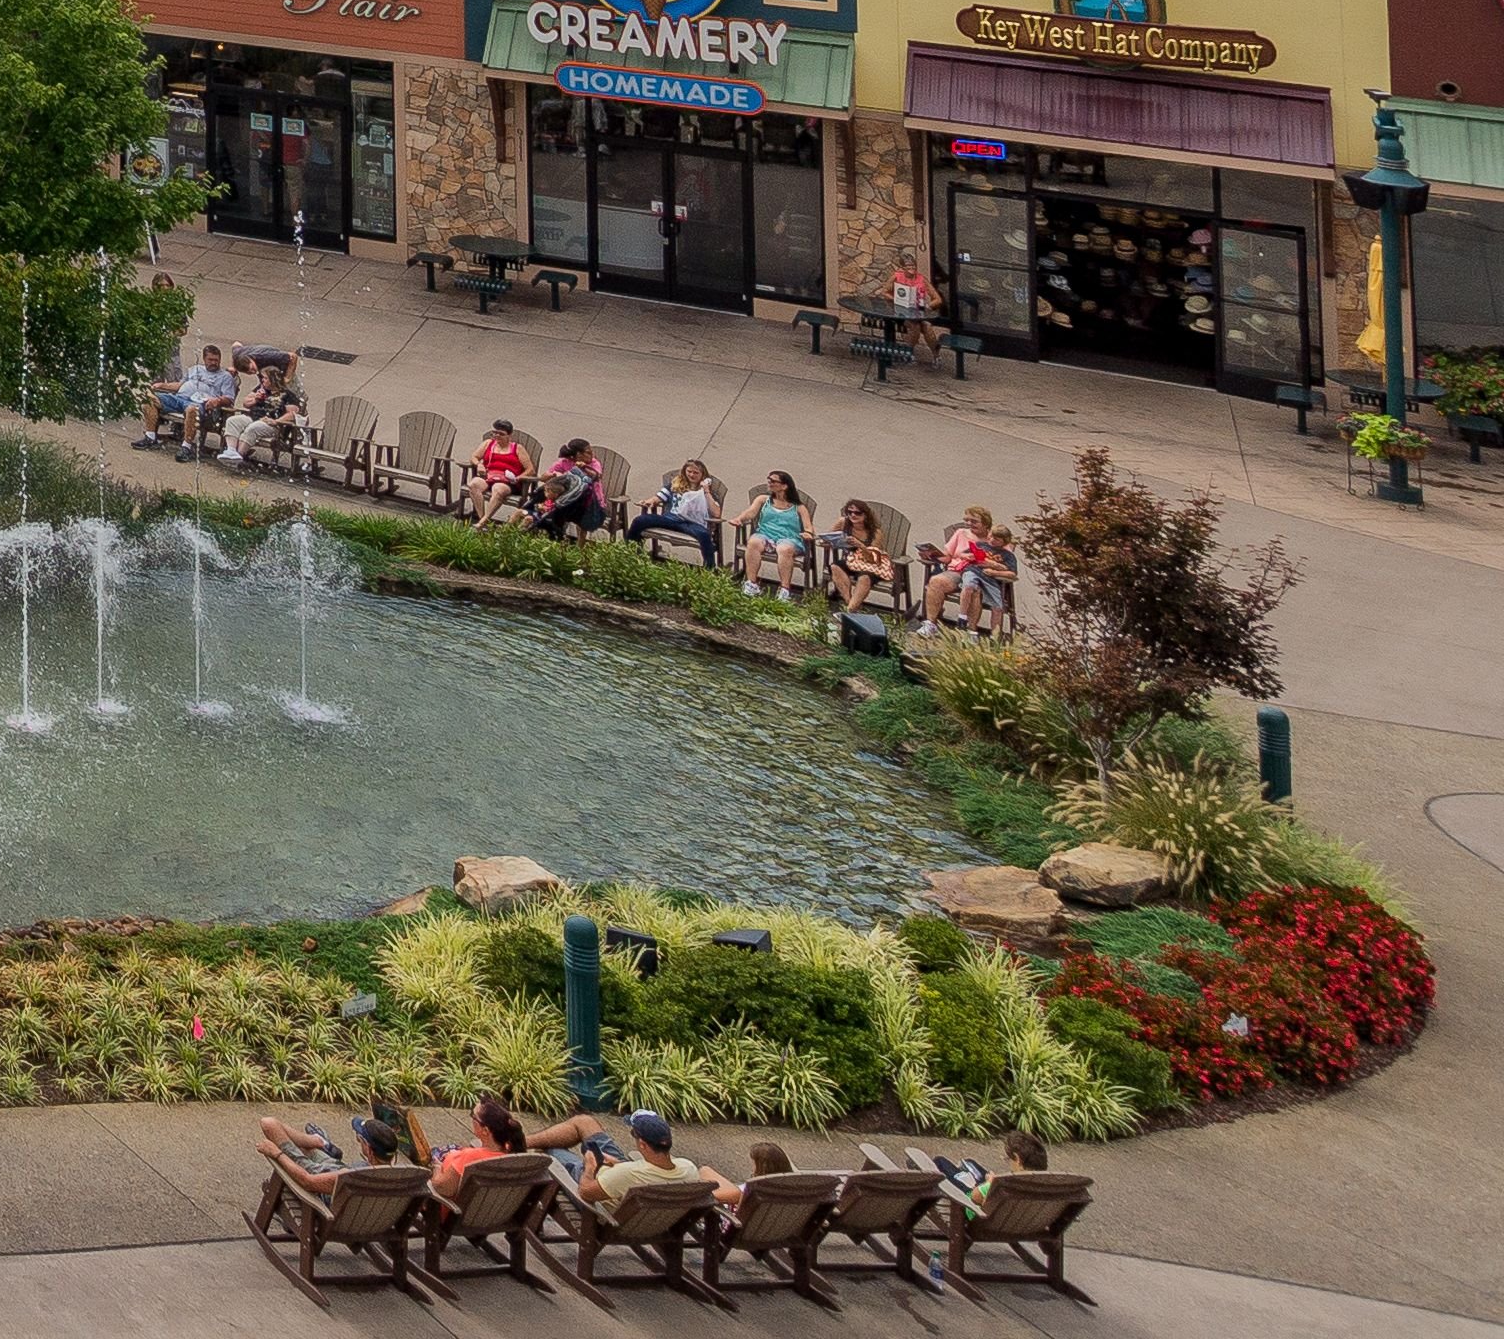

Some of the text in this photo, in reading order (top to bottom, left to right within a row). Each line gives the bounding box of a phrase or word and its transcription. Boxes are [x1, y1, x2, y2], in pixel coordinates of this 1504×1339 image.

[526, 1, 787, 66] CREAMERY
[975, 8, 1263, 73] Key West Hat Company
[568, 69, 750, 109] HOMEMADE
[952, 141, 1002, 156] OPEN
